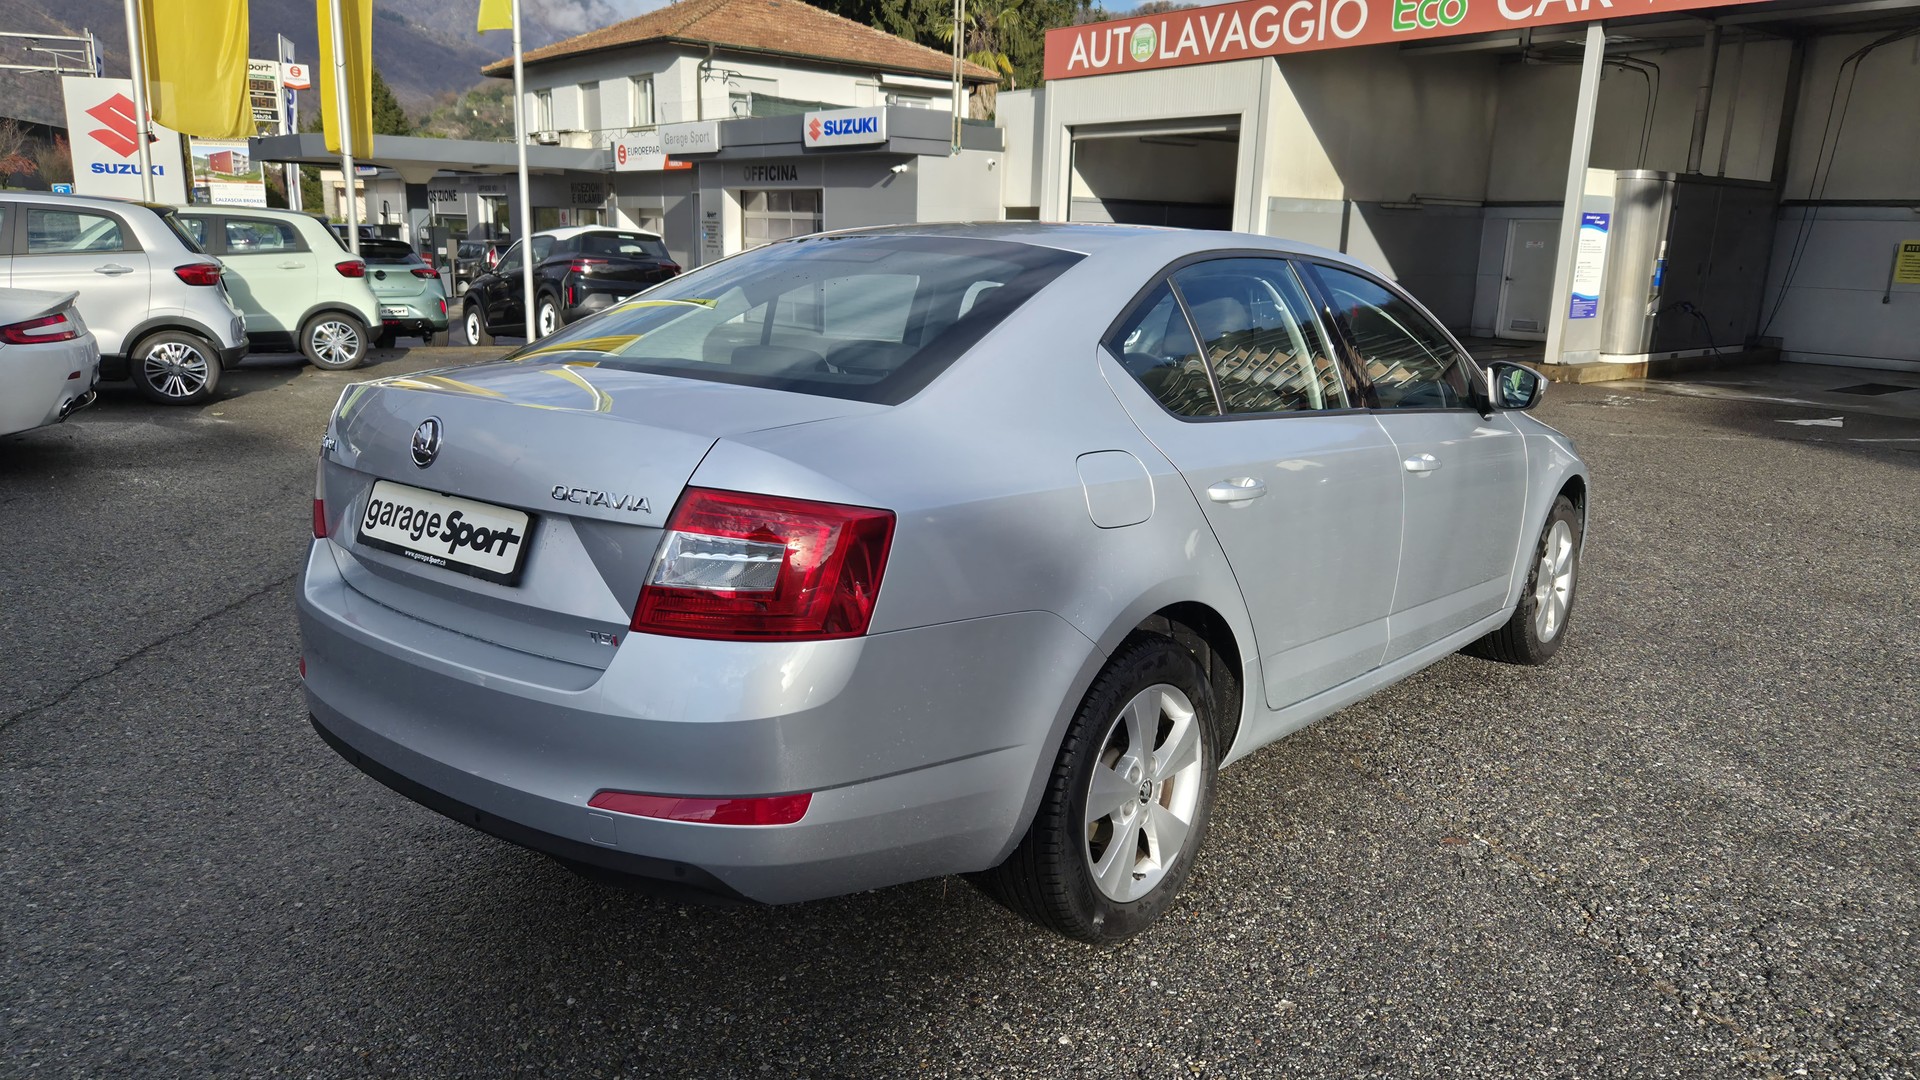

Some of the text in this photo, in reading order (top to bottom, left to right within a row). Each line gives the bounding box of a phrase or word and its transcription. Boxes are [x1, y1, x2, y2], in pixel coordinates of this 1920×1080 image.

[824, 117, 877, 136] SUZUKI
[664, 131, 710, 146] Garage Sport
[627, 145, 660, 156] EUROREPAR
[744, 165, 798, 181] OFFICINA
[552, 484, 651, 514] OCTAVIA
[585, 629, 618, 649] TSI
